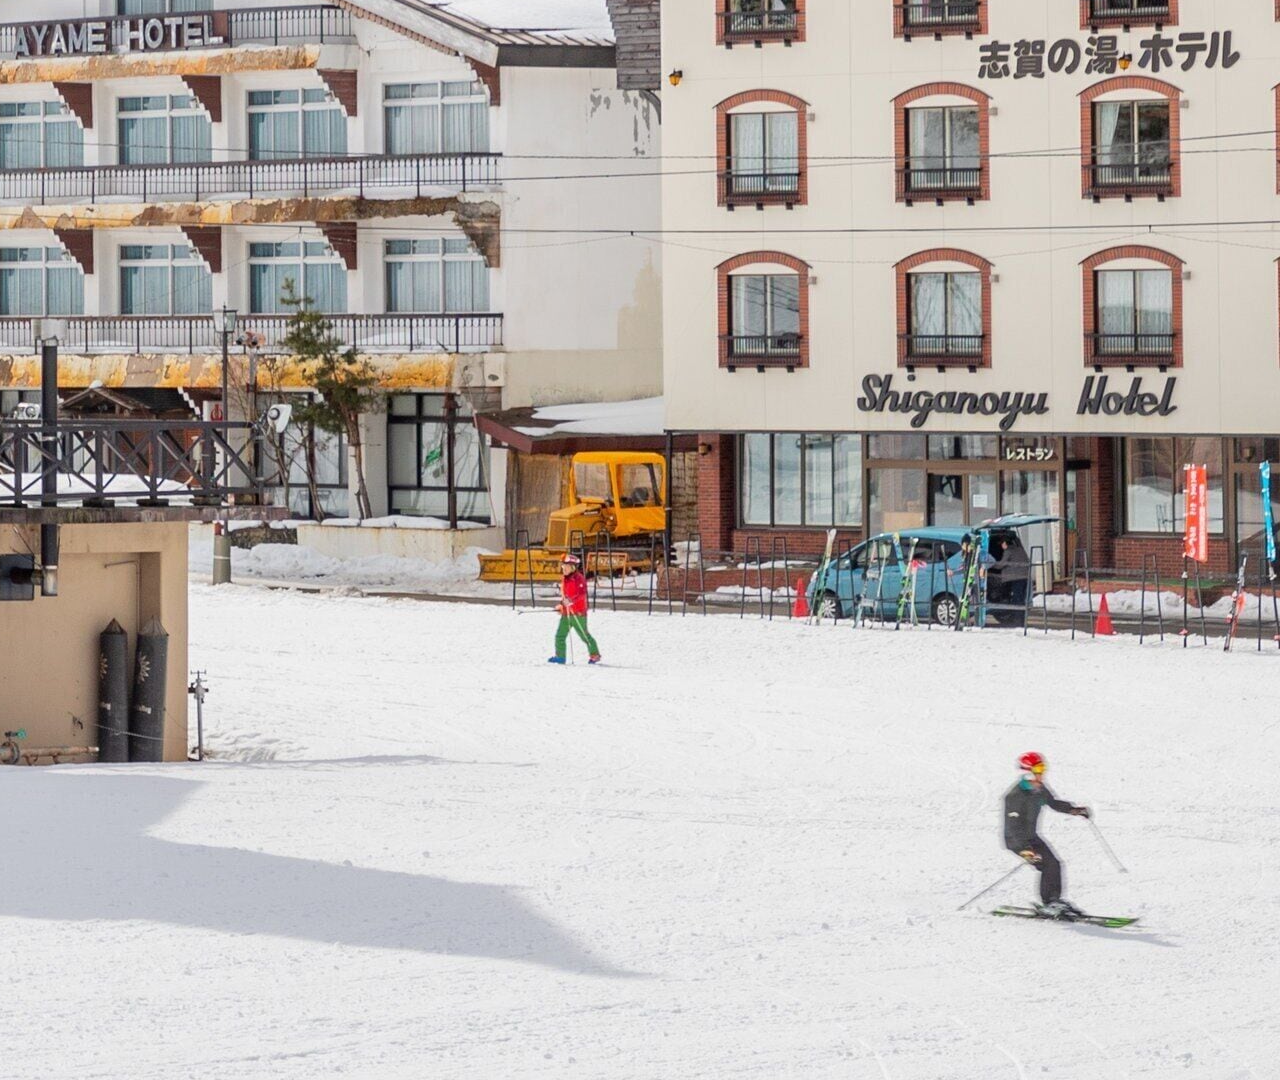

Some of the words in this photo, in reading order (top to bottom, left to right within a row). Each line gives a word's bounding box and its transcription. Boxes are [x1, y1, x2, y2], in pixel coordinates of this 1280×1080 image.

[14, 21, 106, 57] AYAME
[124, 15, 224, 51] HOTEL
[857, 373, 1050, 431] Shiganoyu
[1076, 375, 1178, 417] Hotel
[1006, 447, 1054, 461] レストラン
